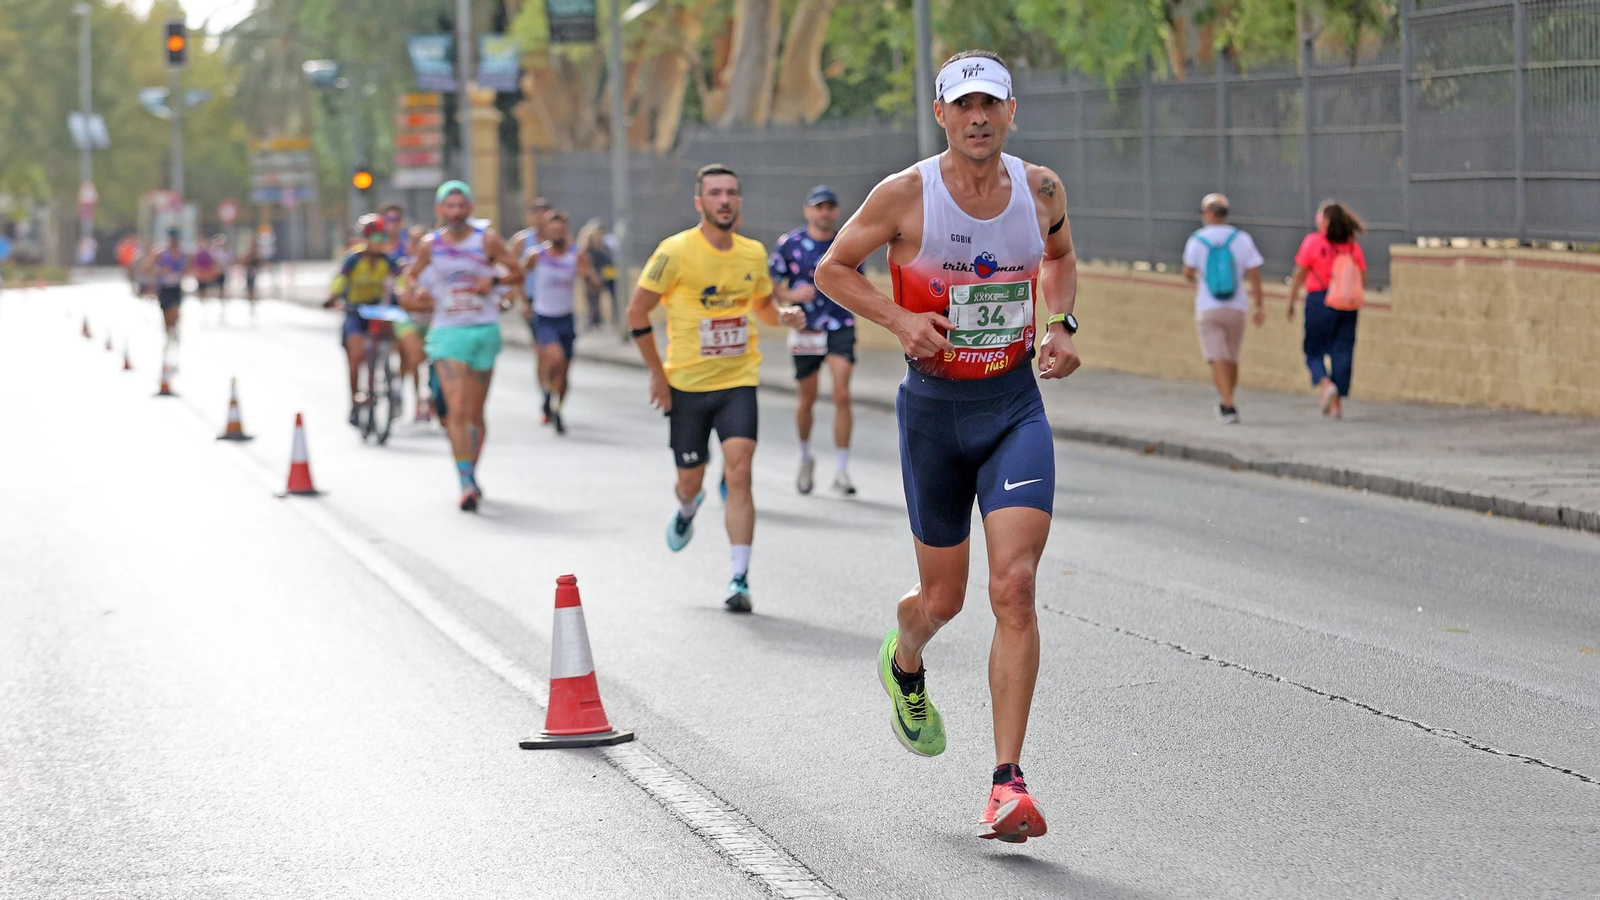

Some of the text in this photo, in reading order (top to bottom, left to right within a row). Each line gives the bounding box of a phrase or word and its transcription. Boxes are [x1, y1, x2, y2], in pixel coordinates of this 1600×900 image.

[950, 233, 972, 244] GOBIK
[942, 261, 1025, 273] triki man
[976, 305, 1005, 327] 34
[713, 331, 739, 344] 517
[979, 331, 1020, 345] MIZU
